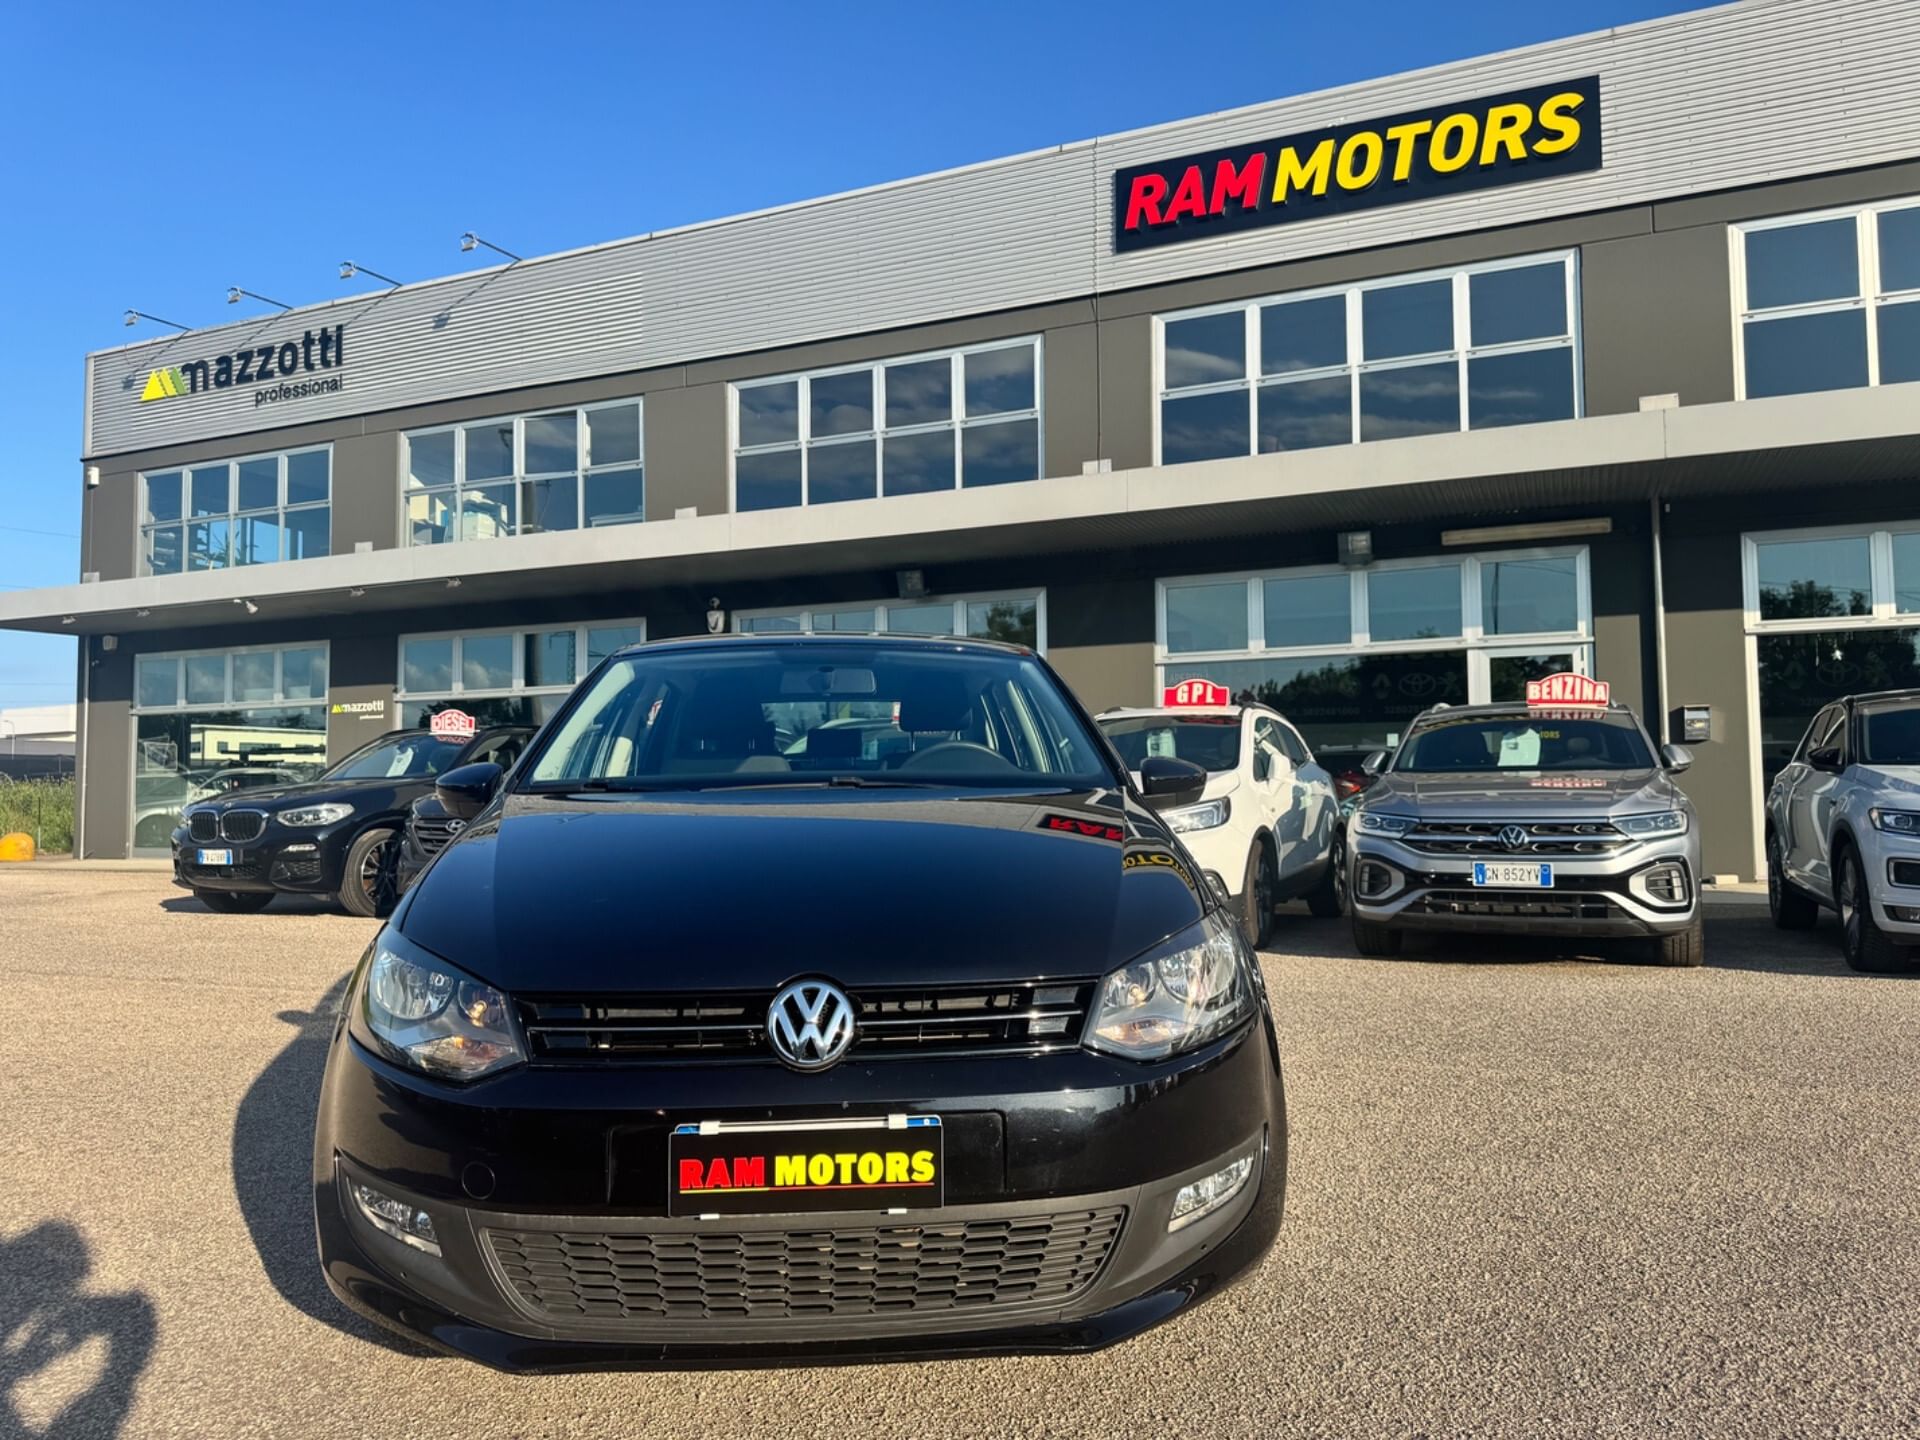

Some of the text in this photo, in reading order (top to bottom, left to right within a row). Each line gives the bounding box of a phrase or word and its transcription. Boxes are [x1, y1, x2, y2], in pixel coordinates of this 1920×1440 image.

[1124, 92, 1584, 231] RAM MOTORS
[181, 324, 343, 393] mazzotti
[255, 374, 343, 408] professional
[1177, 683, 1215, 703] GPL
[1528, 676, 1606, 700] BENZINA
[341, 700, 384, 712] mazzotti
[431, 713, 471, 731] DIESEL
[1504, 868, 1540, 881] 852YV
[679, 1151, 935, 1189] RAM MOTORS
